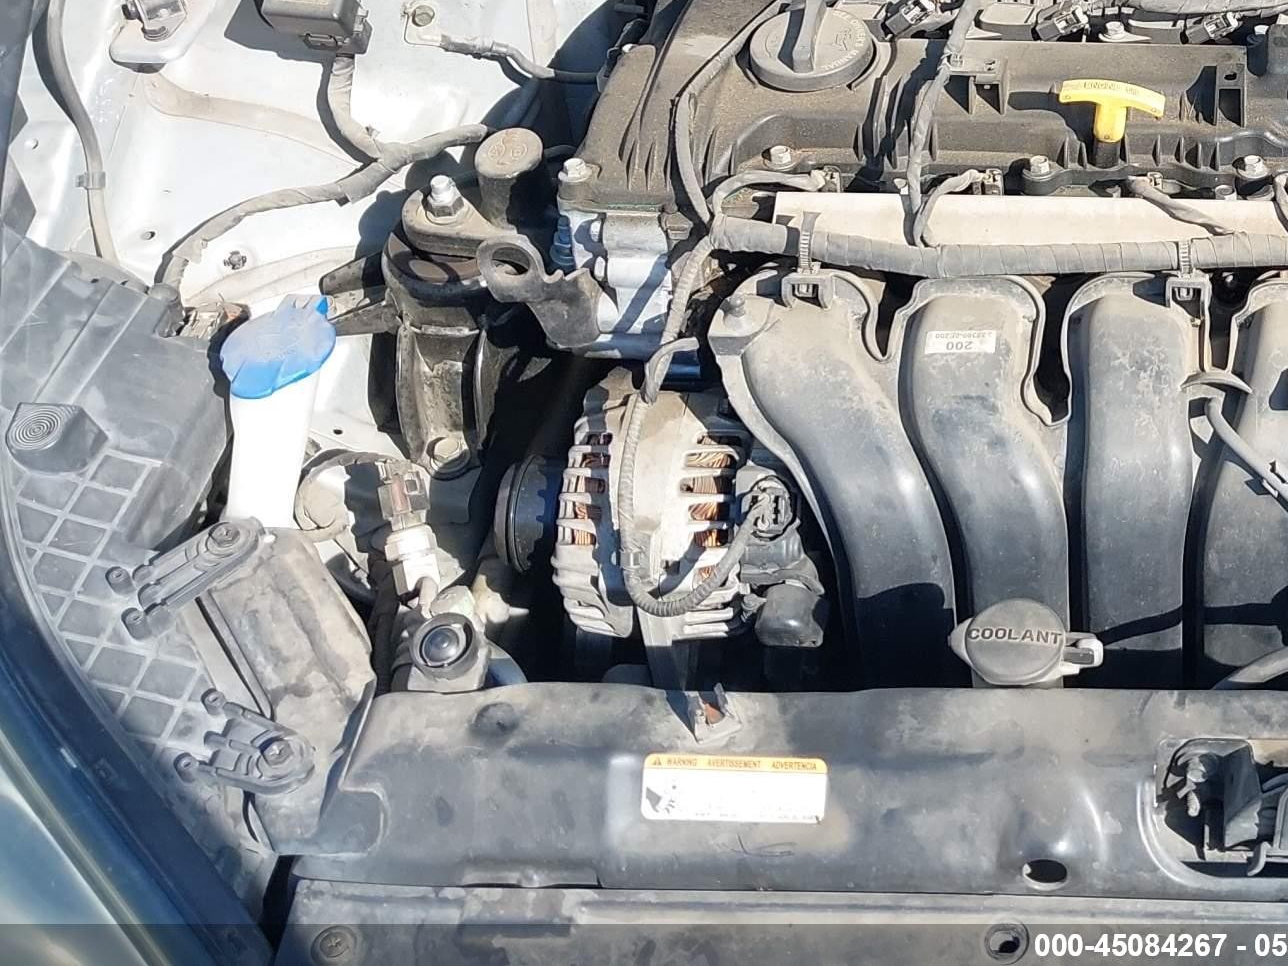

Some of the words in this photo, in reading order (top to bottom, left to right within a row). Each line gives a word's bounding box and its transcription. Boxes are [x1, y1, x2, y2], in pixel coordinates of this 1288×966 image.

[945, 340, 973, 351] 200
[967, 627, 1062, 645] COOLANT
[666, 759, 698, 767] WARNING
[708, 759, 761, 769] AVERTISSEMENT
[772, 761, 817, 771] ADVERTENCIA
